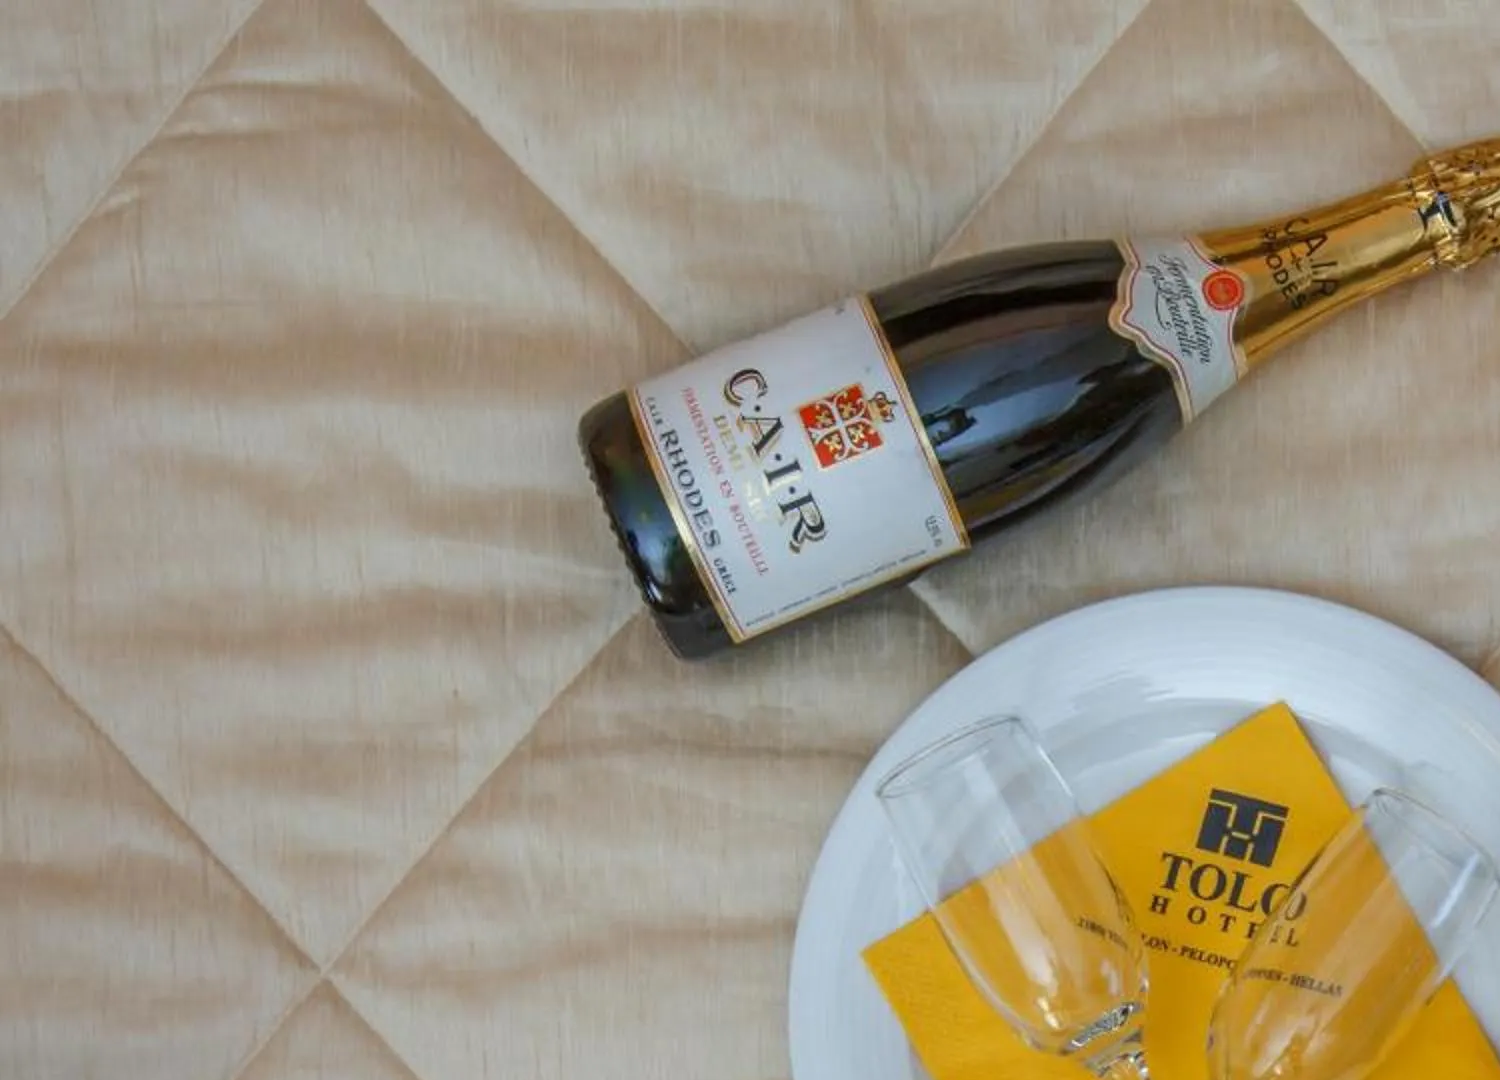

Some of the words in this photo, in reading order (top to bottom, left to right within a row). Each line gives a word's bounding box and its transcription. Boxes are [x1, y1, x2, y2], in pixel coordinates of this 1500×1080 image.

[660, 428, 723, 551] RHODES
[718, 479, 737, 502] EN
[1160, 850, 1309, 920] TOLO
